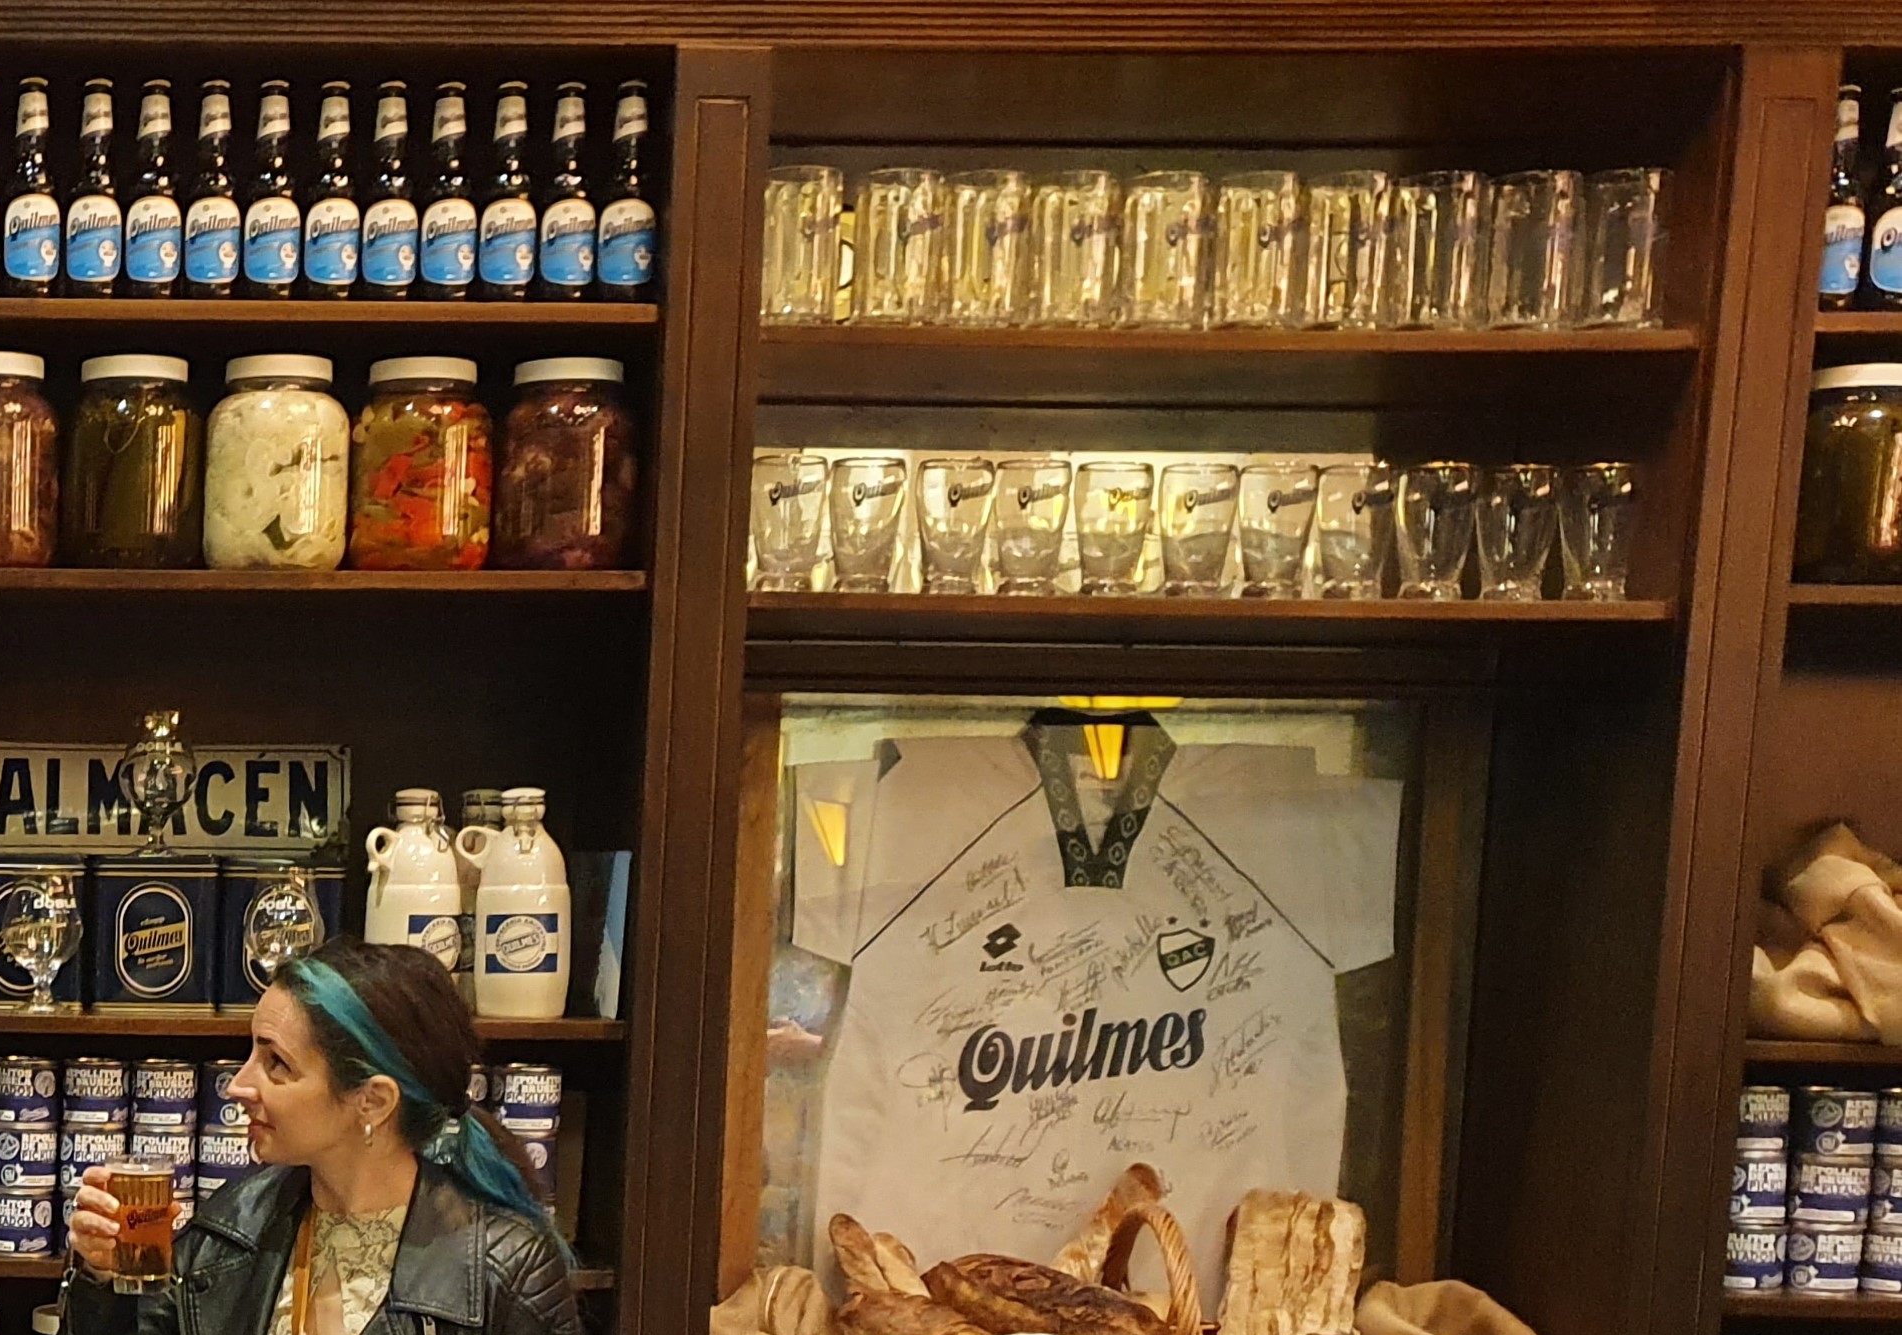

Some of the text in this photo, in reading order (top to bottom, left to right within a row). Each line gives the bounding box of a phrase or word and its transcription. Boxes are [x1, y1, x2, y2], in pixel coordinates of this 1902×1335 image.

[125, 929, 183, 959] Quilmes
[1166, 943, 1208, 968] QAC
[958, 1007, 1207, 1113] Quilmes
